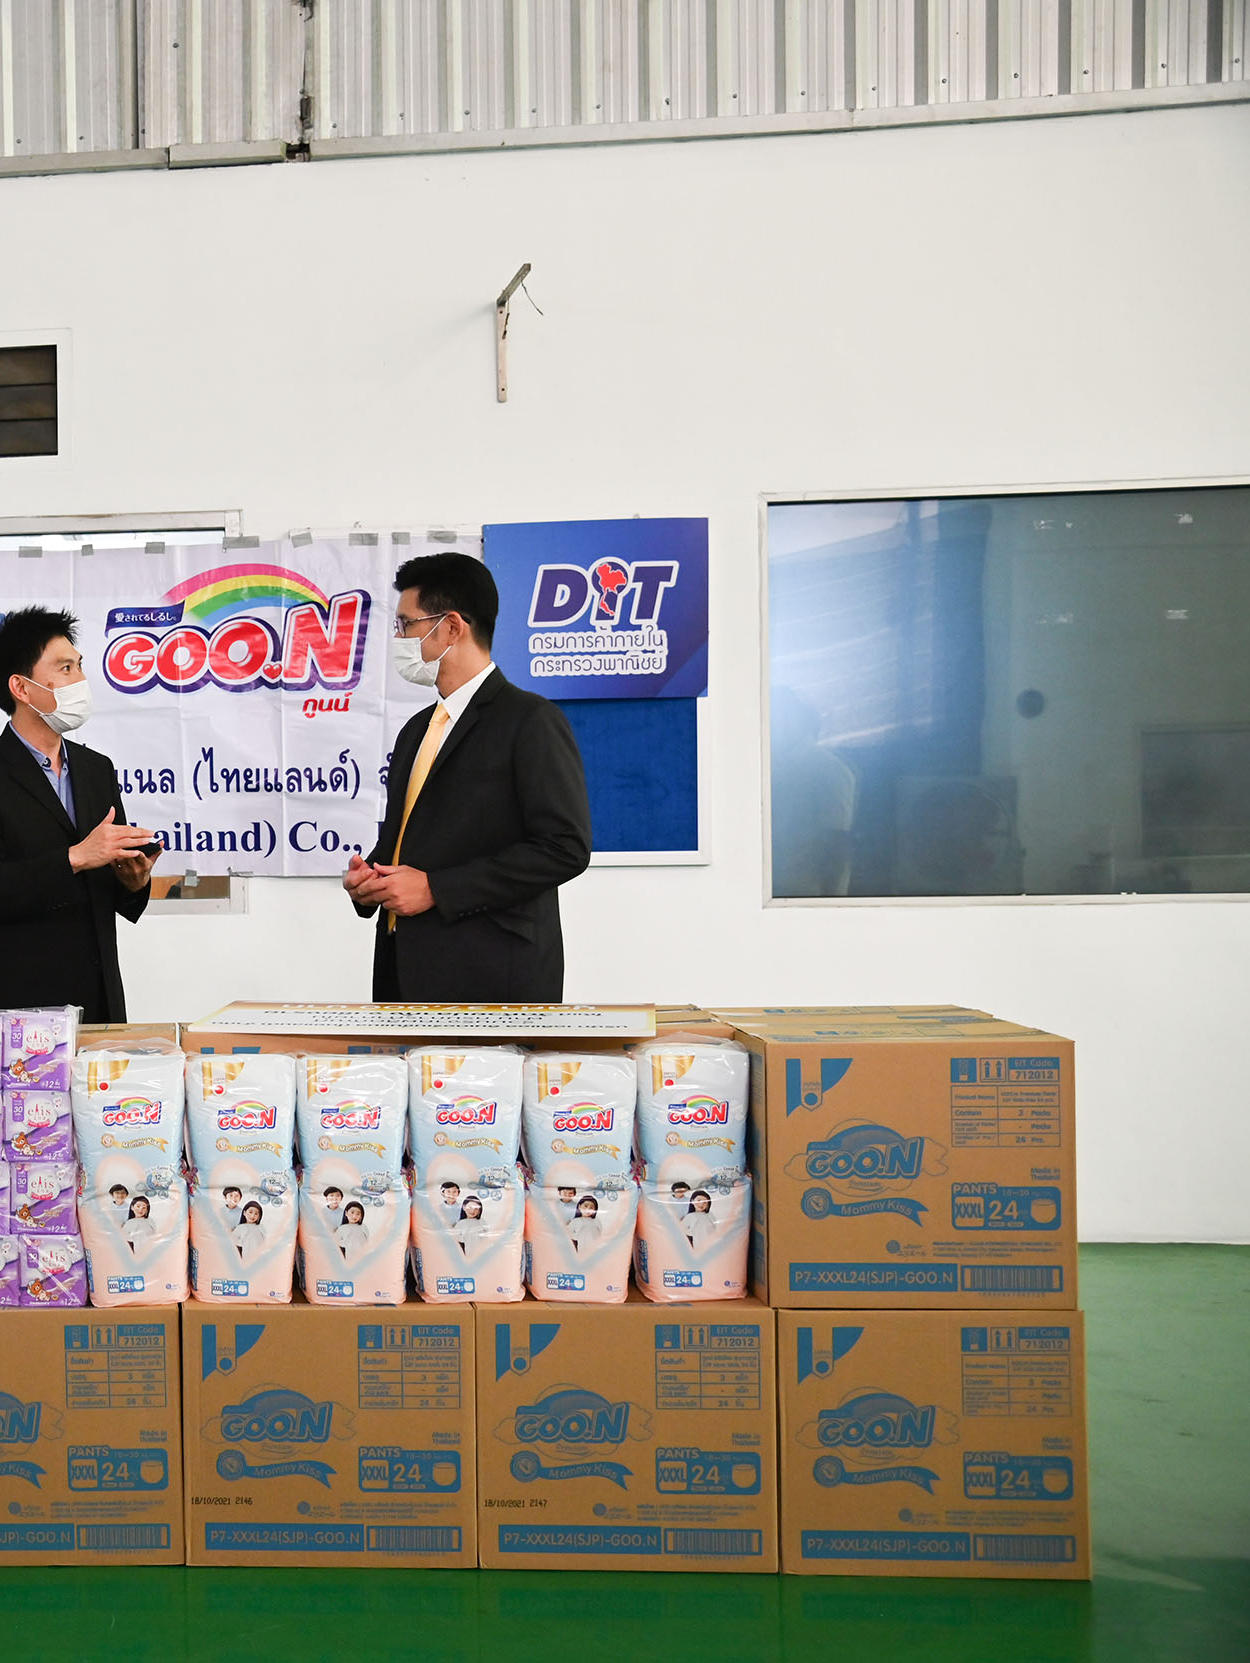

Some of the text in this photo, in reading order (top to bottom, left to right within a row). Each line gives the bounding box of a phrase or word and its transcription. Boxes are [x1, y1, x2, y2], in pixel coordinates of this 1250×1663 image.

[115, 612, 172, 623] 愛されてるしるし
[532, 625, 663, 650] กรมการค้าภายใน
[534, 651, 663, 673] กระทรวงพาณิชย์
[302, 692, 352, 718] กูนน์
[192, 747, 361, 800] (ไทยแลนด์)
[289, 821, 362, 856] Co.,
[1015, 1071, 1053, 1079] 712012
[953, 1184, 997, 1194] PANTS
[841, 1200, 912, 1216] Mommy Kiss
[988, 1200, 1018, 1220] 24
[124, 1337, 160, 1346] 712012
[418, 1338, 454, 1346] 712012
[716, 1338, 754, 1346] 712012
[68, 1447, 110, 1456] PANTS
[360, 1448, 400, 1457] PANTS
[657, 1449, 700, 1458] PANTS
[964, 1453, 1008, 1463] PANTS
[8, 1464, 32, 1478] Kiss
[102, 1462, 130, 1480] 24
[254, 1463, 322, 1478] Mommy Kiss
[392, 1464, 422, 1482] 24
[549, 1464, 617, 1480] Mommy Kiss
[691, 1465, 720, 1484] 24
[1001, 1469, 1030, 1489] 24
